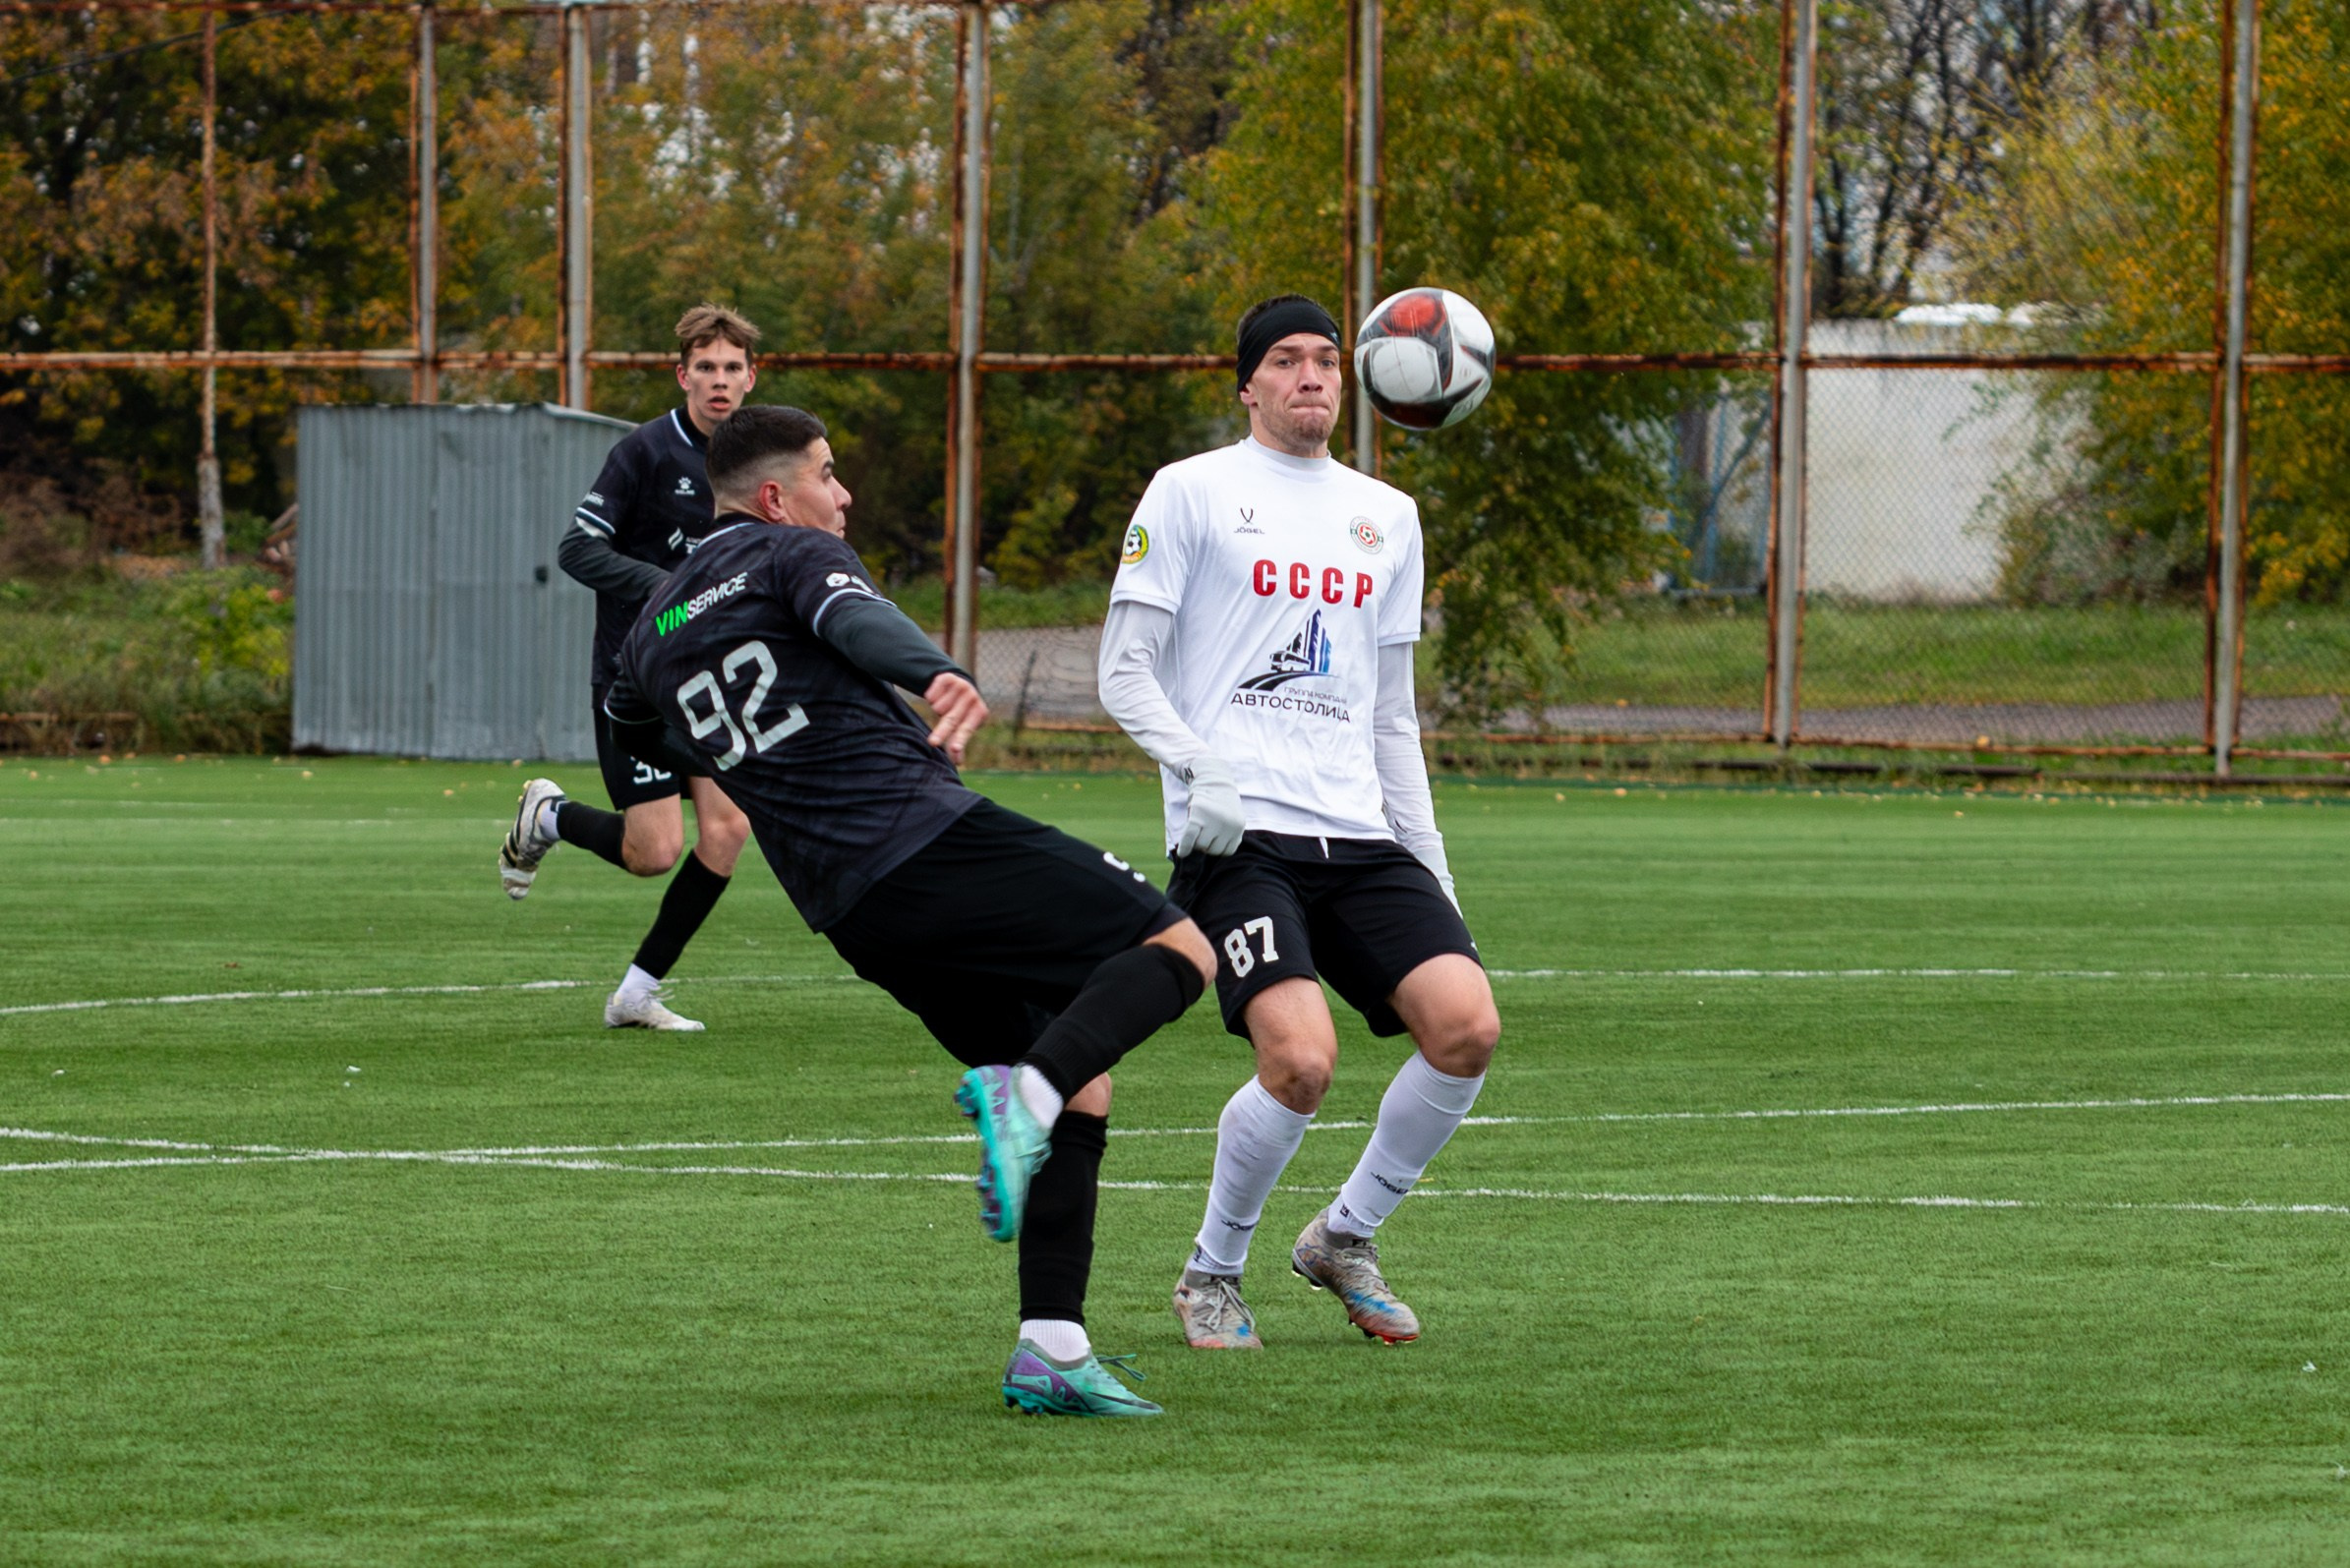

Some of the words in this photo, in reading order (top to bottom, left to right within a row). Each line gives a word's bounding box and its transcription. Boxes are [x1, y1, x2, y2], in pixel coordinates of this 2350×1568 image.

[1253, 558, 1374, 609] СССР
[676, 640, 811, 772] 92
[1230, 692, 1351, 724] АВТОСТОЛИЦА
[1223, 915, 1280, 978] 87
